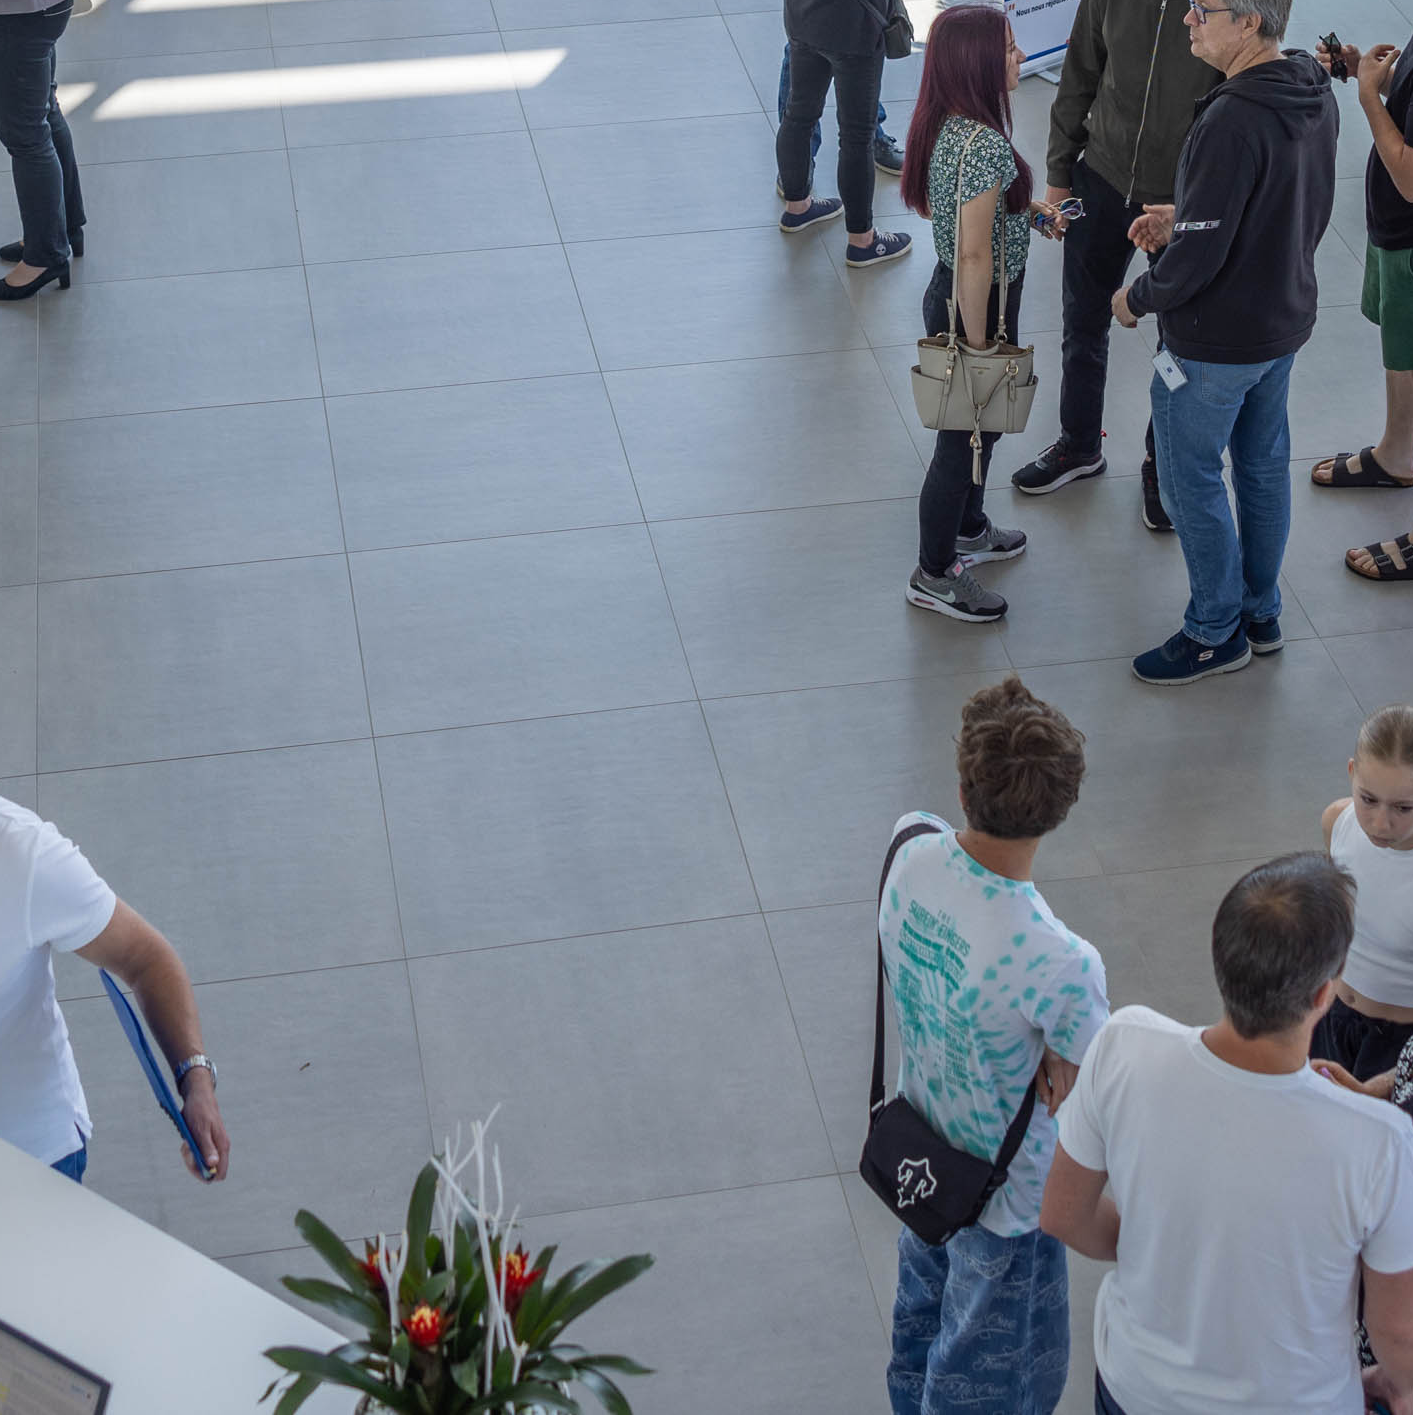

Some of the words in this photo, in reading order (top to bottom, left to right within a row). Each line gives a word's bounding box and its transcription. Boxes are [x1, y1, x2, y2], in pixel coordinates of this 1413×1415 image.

[1016, 7, 1031, 17] Nous
[1031, 3, 1045, 13] nous
[938, 923, 971, 958] FINGERS
